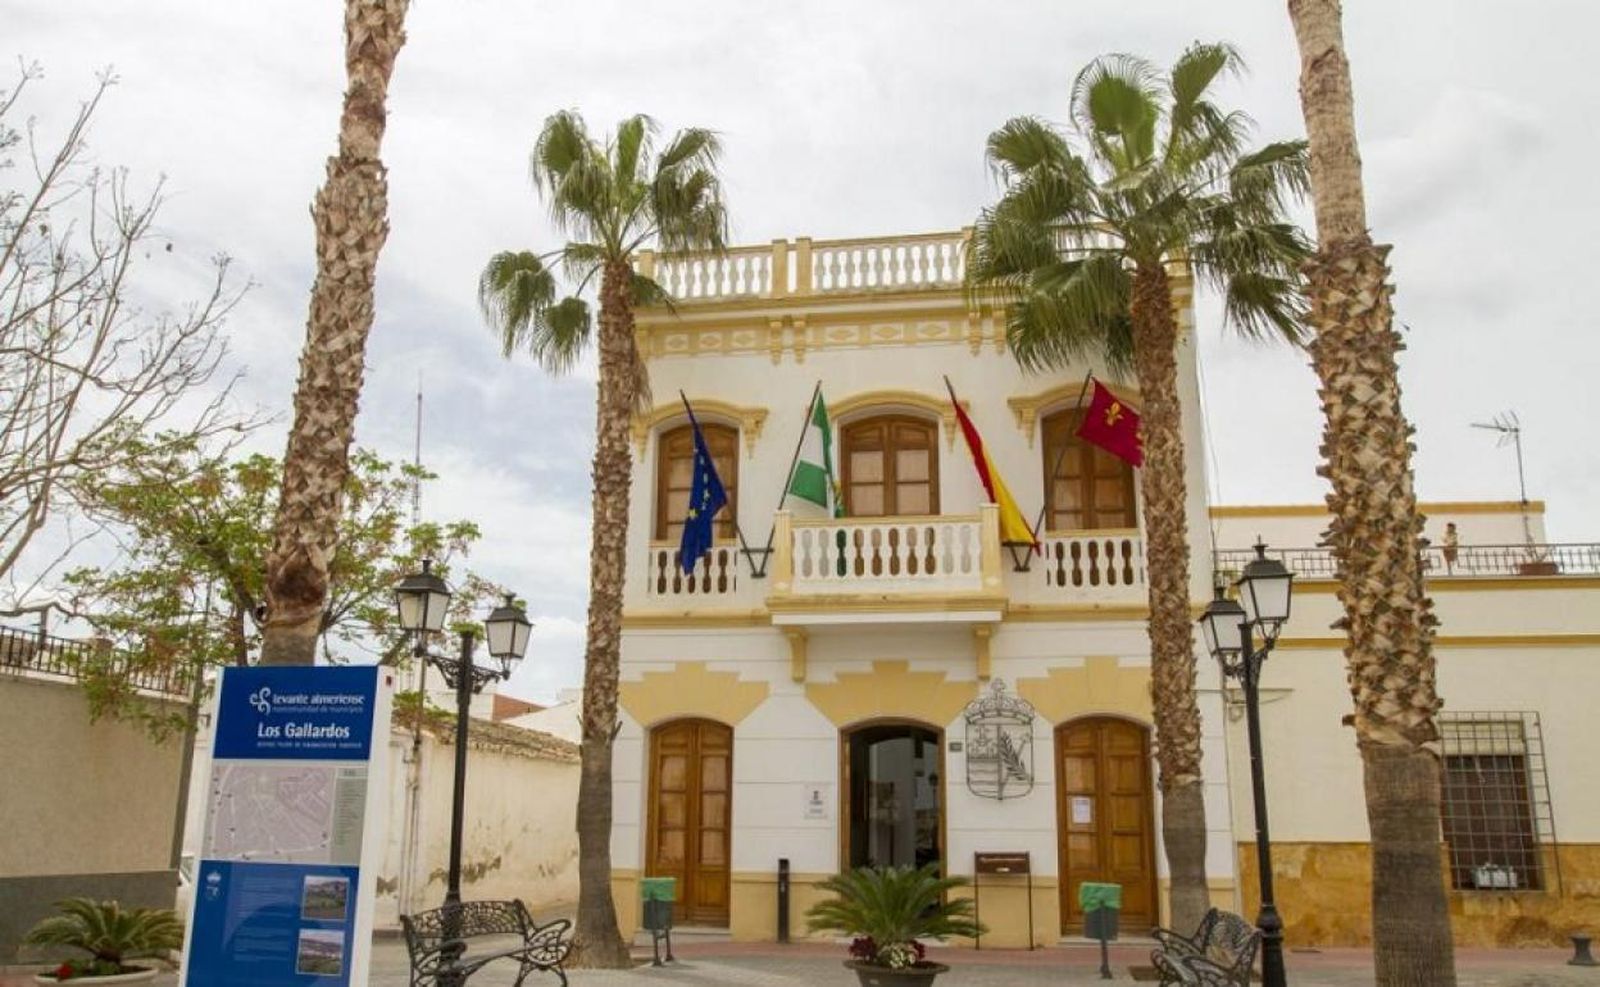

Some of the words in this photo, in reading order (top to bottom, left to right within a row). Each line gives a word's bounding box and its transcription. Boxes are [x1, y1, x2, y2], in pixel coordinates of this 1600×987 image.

[272, 694, 309, 705] levante
[311, 694, 365, 705] almeriense
[257, 722, 281, 738] Los
[284, 722, 350, 738] Gallardos
